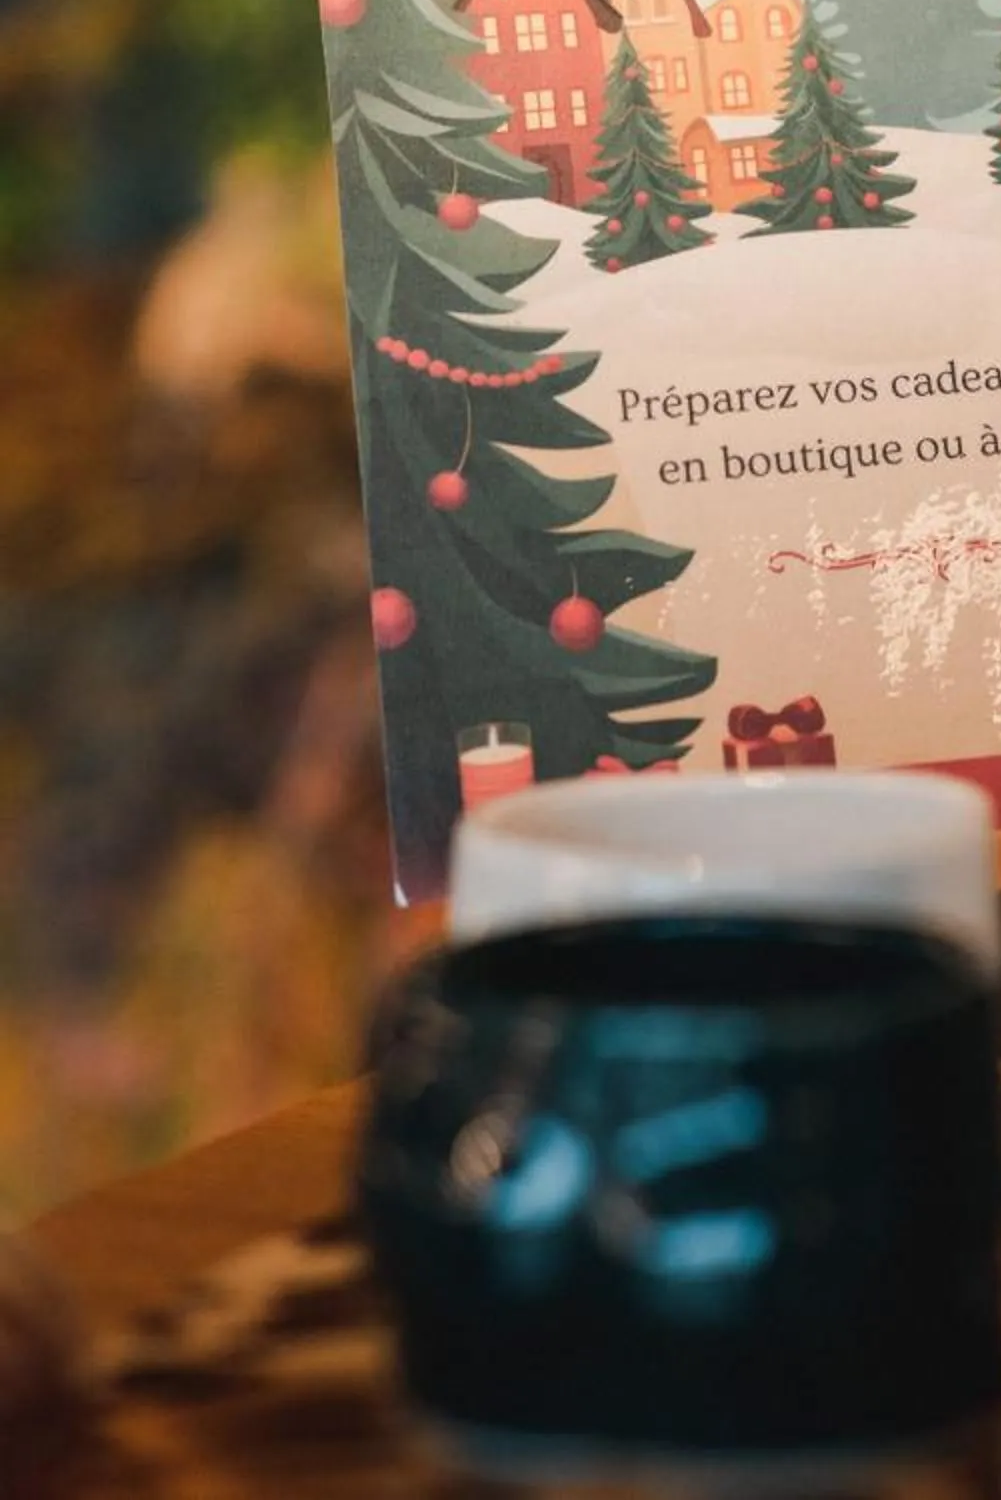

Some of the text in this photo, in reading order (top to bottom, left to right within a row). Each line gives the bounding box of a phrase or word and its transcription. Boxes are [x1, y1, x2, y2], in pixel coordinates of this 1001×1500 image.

[617, 383, 799, 426] Préparez
[809, 375, 878, 405] vos
[658, 457, 709, 485] en
[720, 438, 903, 480] boutique
[915, 434, 967, 463] ou
